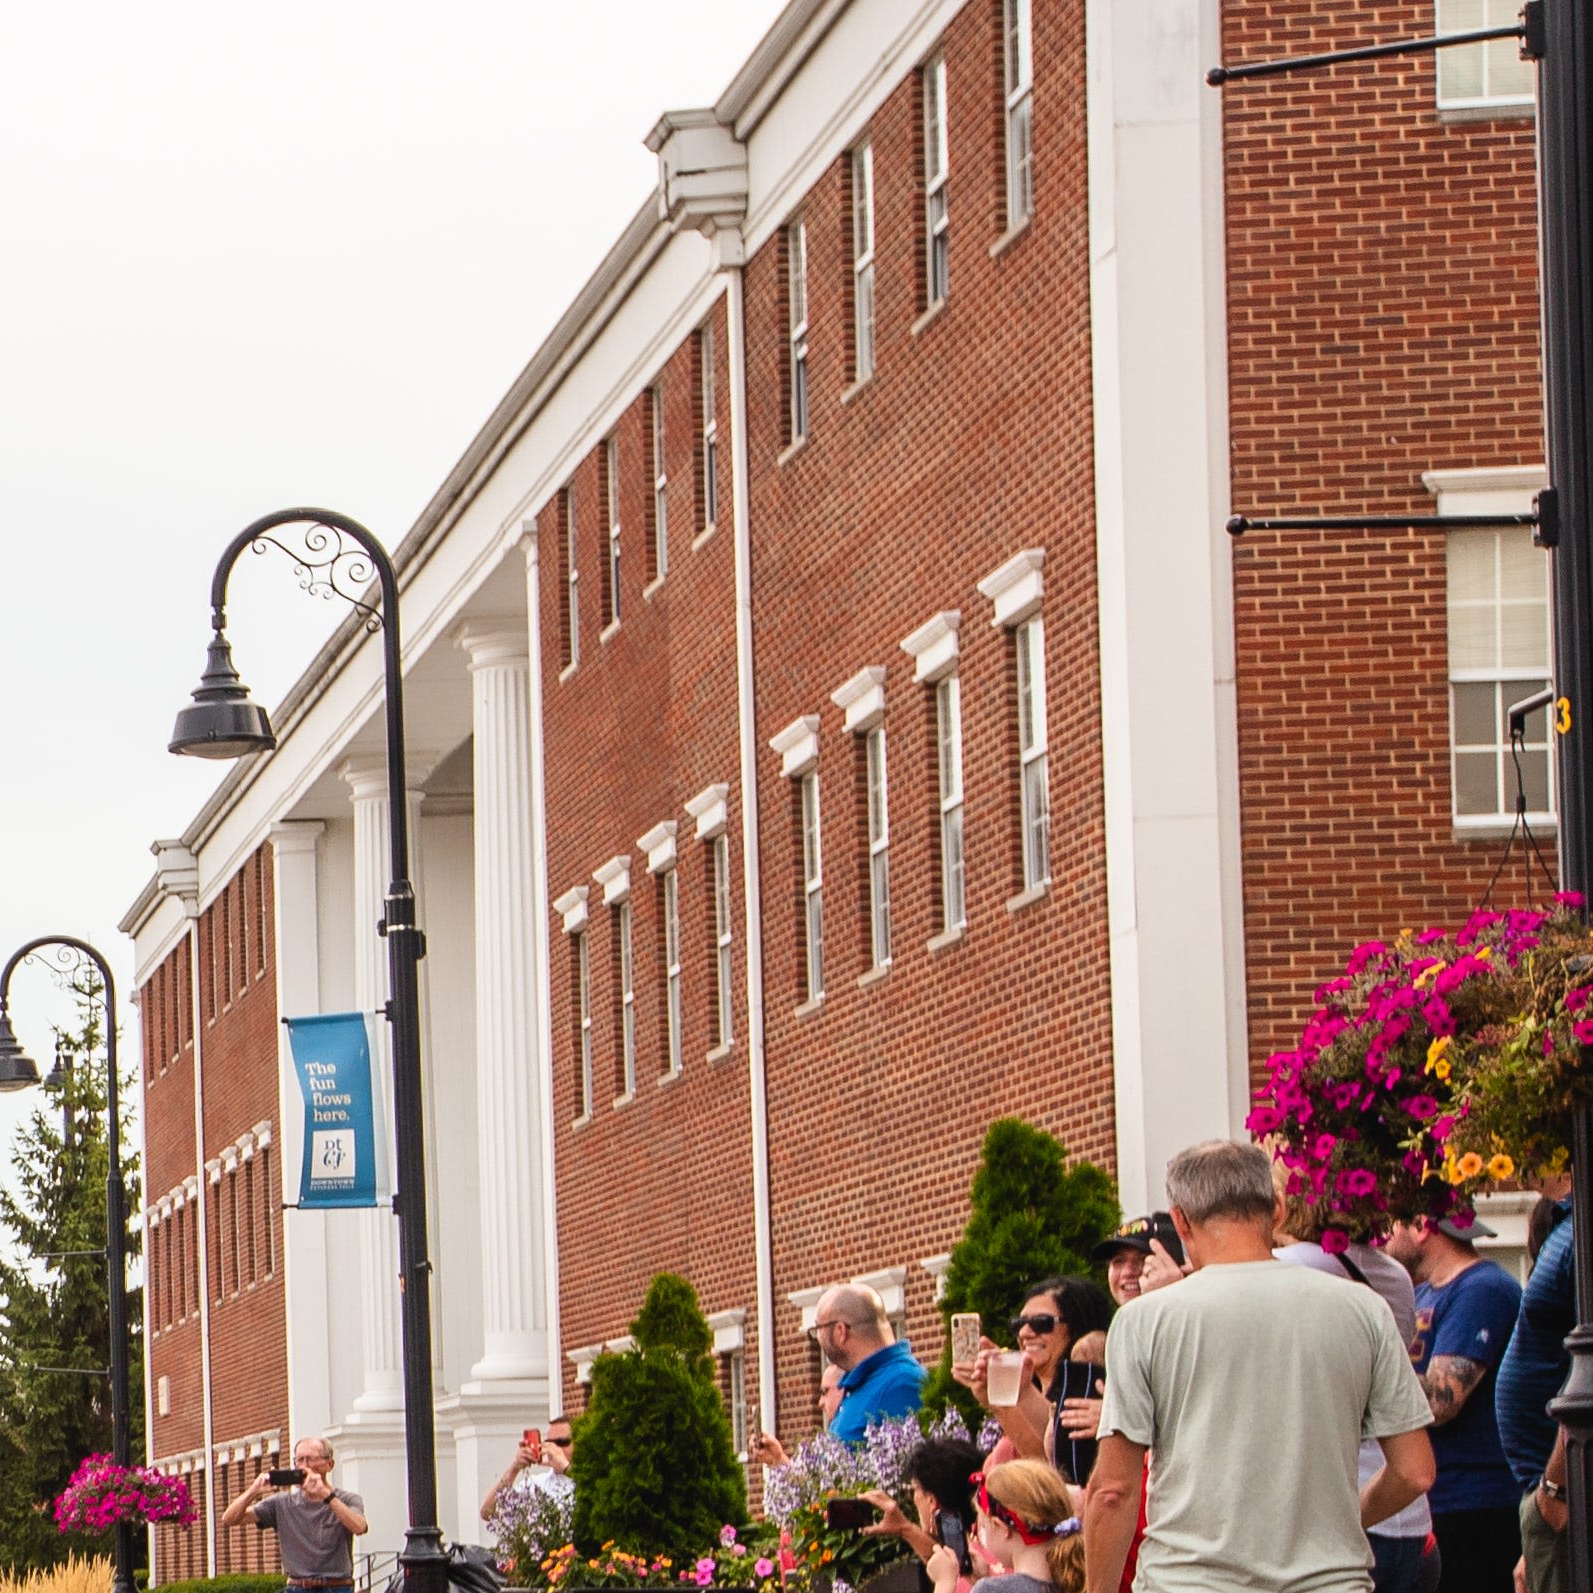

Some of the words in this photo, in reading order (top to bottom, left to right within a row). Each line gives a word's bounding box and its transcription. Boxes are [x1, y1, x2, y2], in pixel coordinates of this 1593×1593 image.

[1556, 696, 1572, 735] 3
[305, 1062, 337, 1074] The
[309, 1077, 336, 1090] fun
[313, 1092, 352, 1106] flows
[313, 1108, 351, 1122] here.
